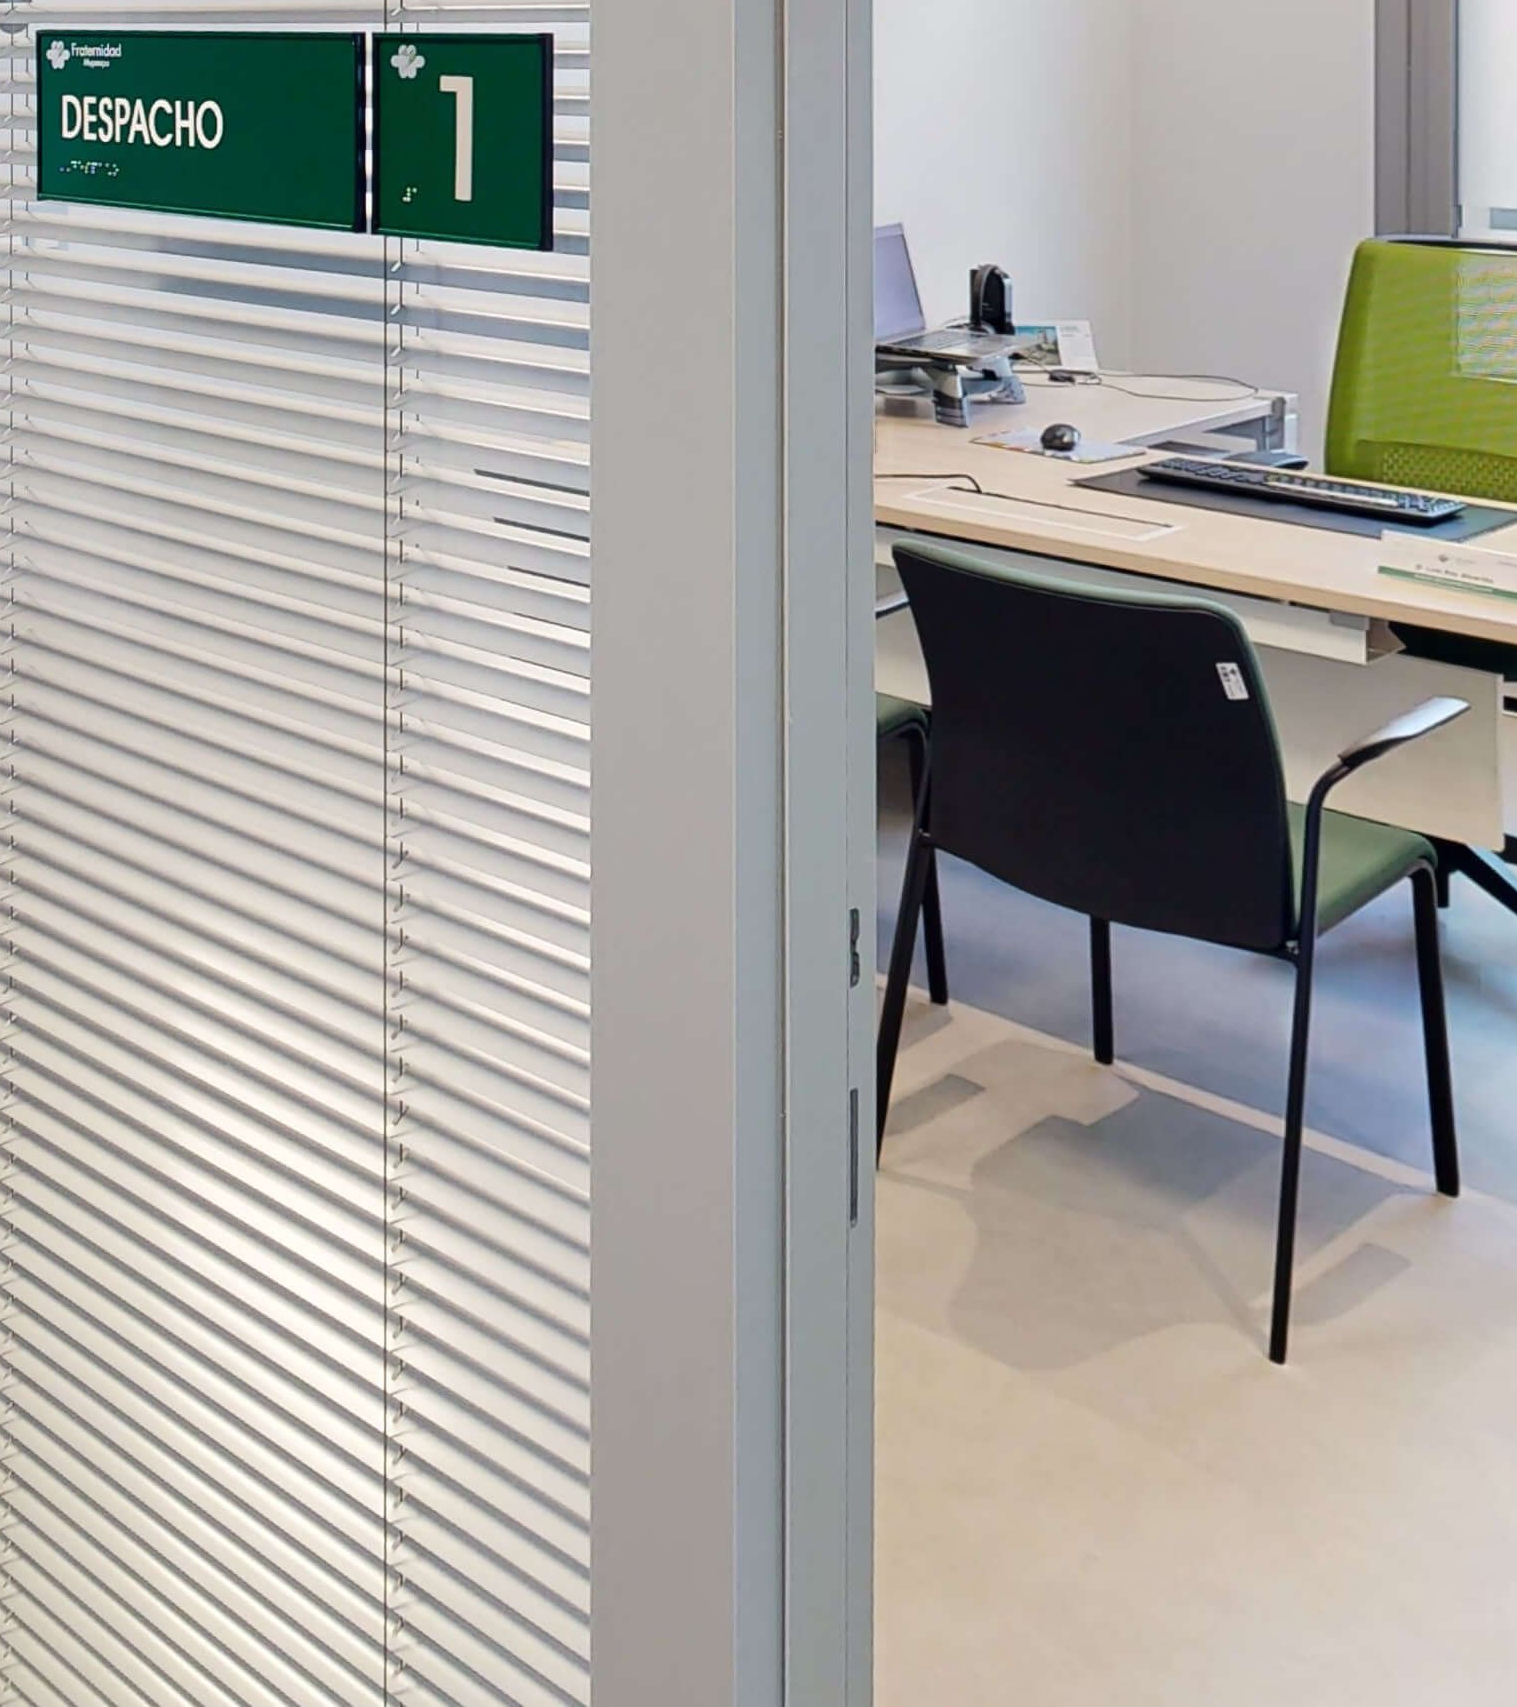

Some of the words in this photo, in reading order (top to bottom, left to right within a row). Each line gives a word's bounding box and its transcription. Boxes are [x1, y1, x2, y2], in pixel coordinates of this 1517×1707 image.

[71, 42, 123, 58] Fraternidad
[61, 94, 224, 149] DESPACHO
[439, 75, 474, 202] 1
